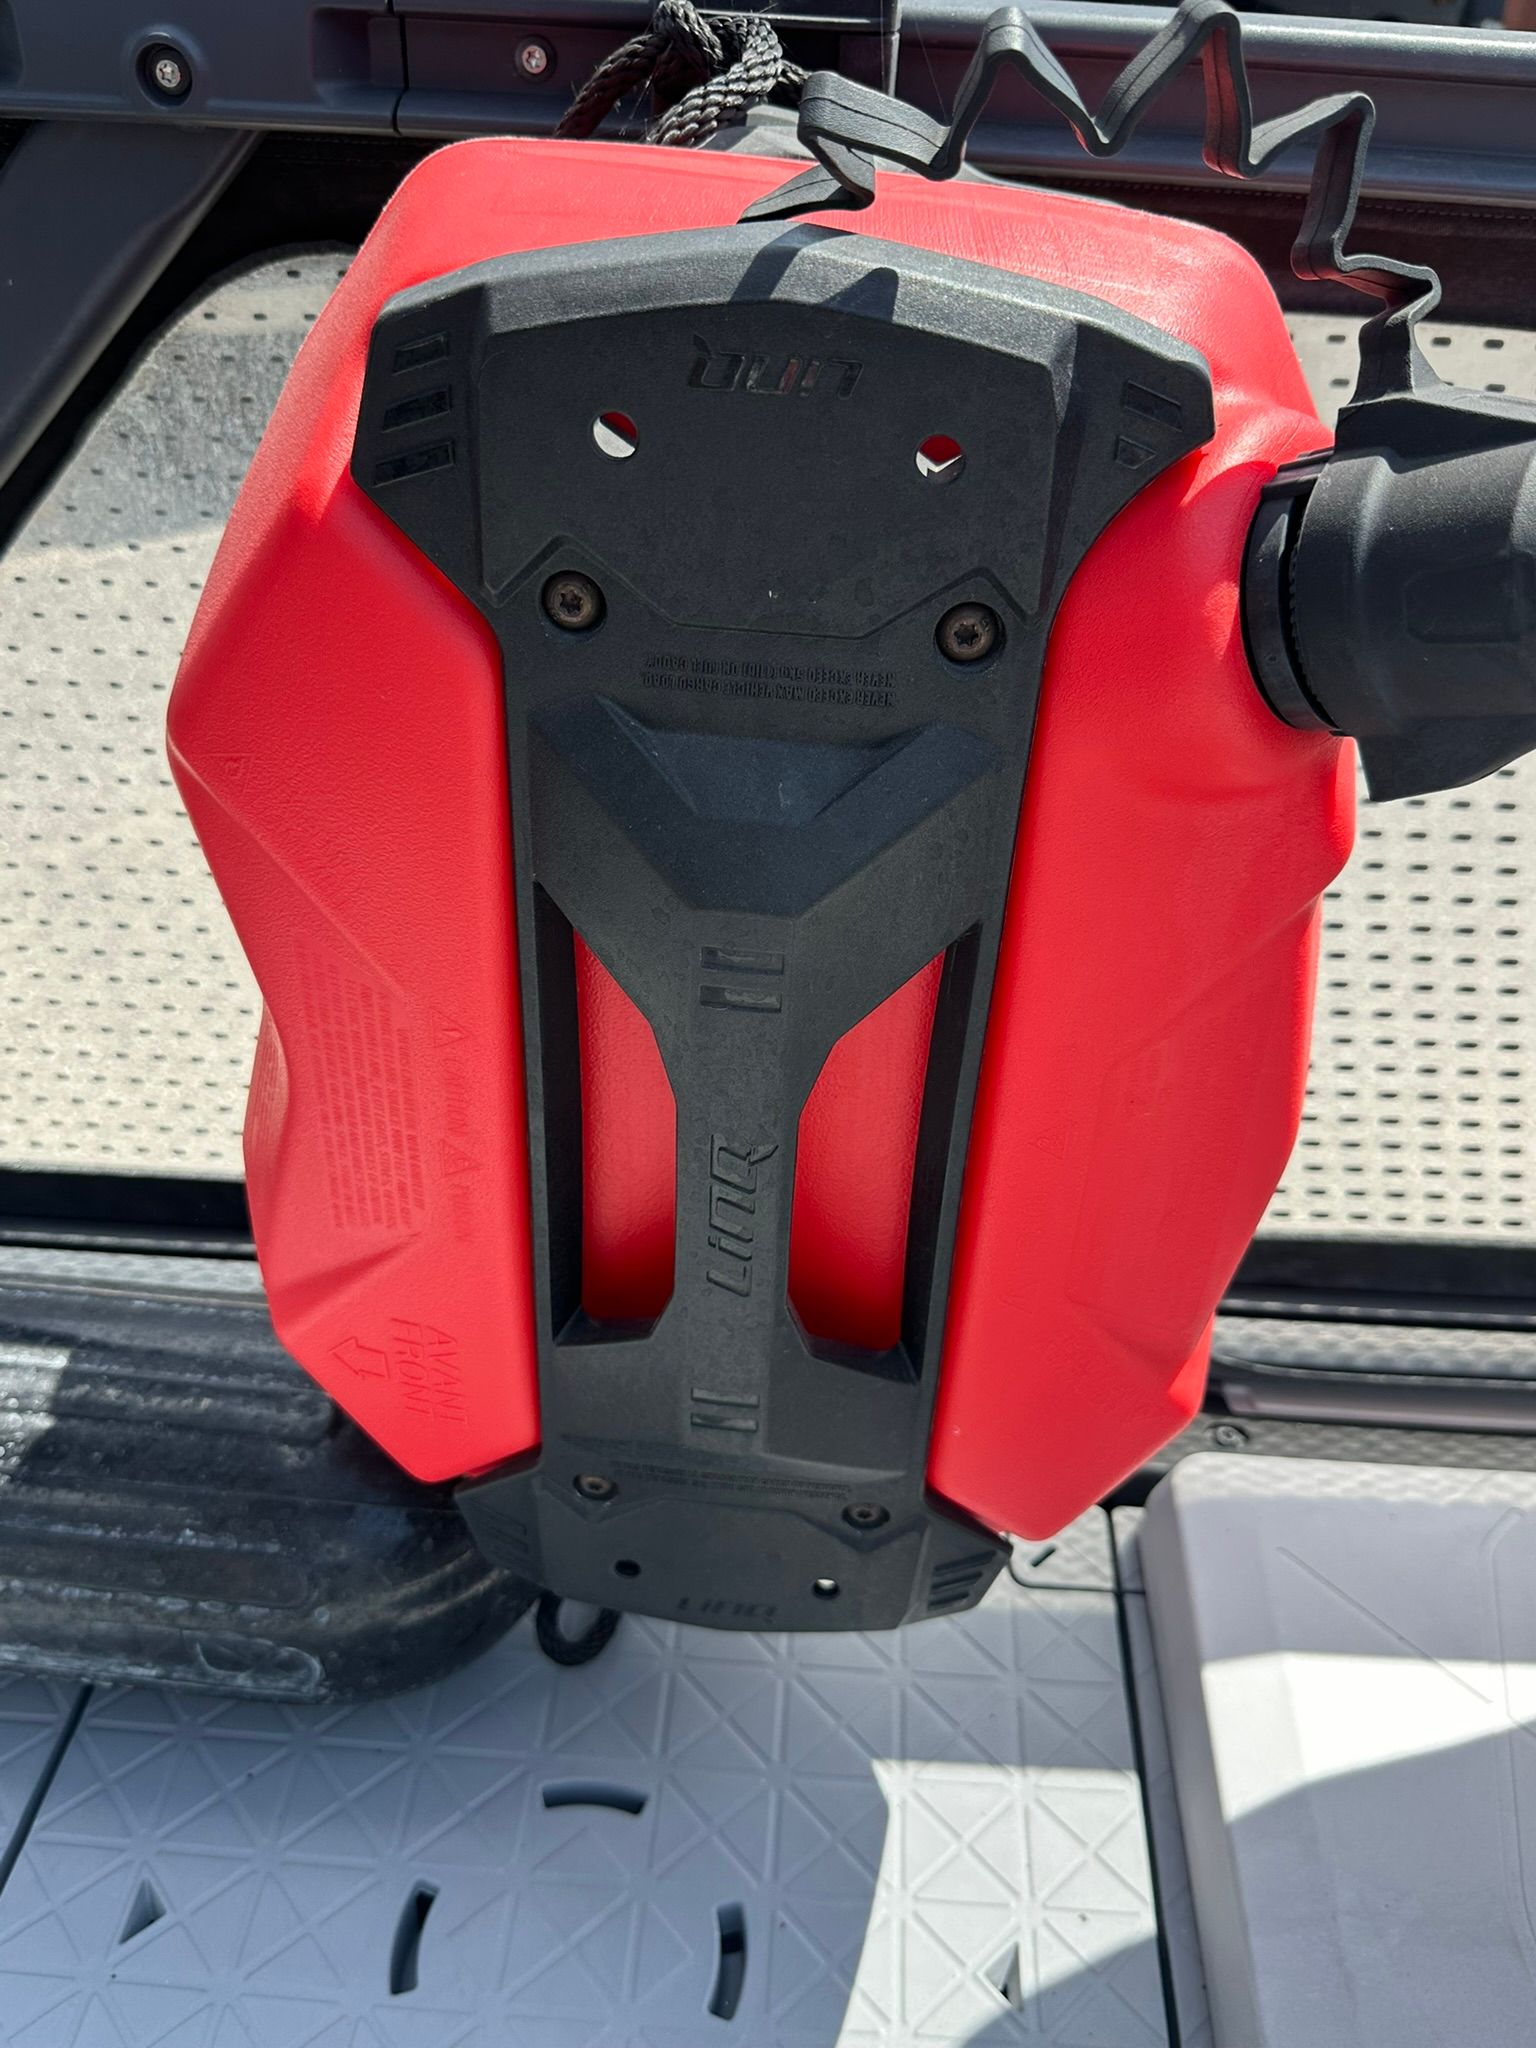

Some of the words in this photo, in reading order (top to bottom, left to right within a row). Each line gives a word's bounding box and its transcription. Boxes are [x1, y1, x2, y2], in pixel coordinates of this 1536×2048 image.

[807, 669, 852, 683] EXCEED
[855, 671, 896, 687] NEVER
[806, 688, 853, 703] EXCEED
[855, 691, 895, 706] NEVER
[389, 1317, 434, 1418] FRONT
